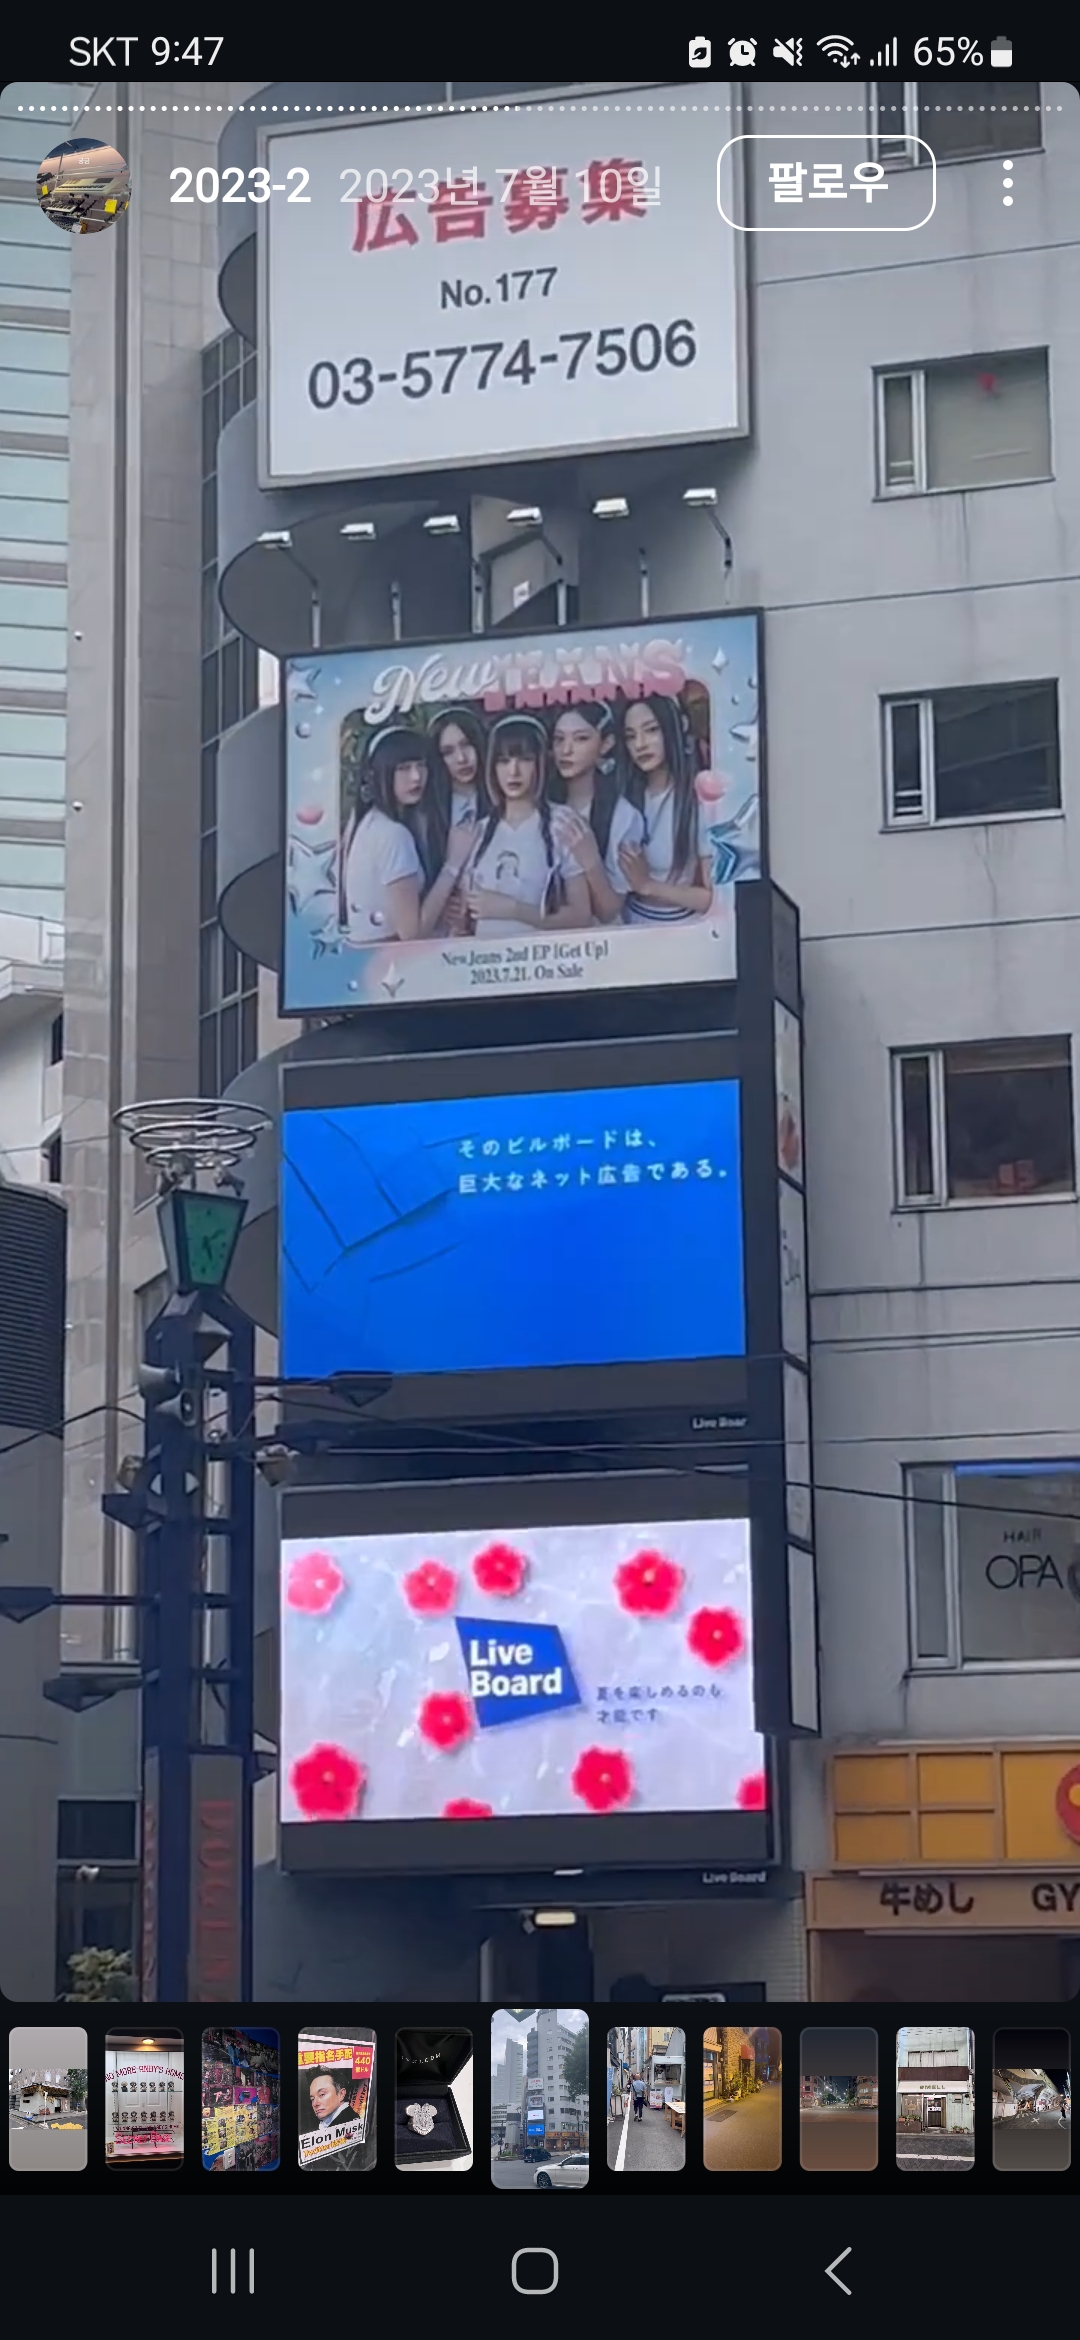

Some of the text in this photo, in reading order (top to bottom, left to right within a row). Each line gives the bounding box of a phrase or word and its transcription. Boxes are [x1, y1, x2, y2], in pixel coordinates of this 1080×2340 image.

[352, 157, 648, 253] 広告募集
[441, 267, 558, 309] No.177
[308, 319, 697, 411] 03-5774-7506
[506, 947, 529, 963] 2nd
[532, 945, 550, 962] EP
[534, 965, 553, 980] On
[557, 963, 583, 979] Sale
[459, 1129, 656, 1159] そのビルボードは、
[459, 1158, 727, 1194] 巨大なネット広告である。
[1003, 1527, 1042, 1543] HAIR
[985, 1554, 1064, 1590] OPA
[469, 1639, 533, 1667] Live
[470, 1667, 563, 1697] Board
[729, 1870, 766, 1883] Board
[879, 1880, 975, 1916] 牛めし
[354, 2056, 371, 2065] 440
[301, 2133, 332, 2150] Elon
